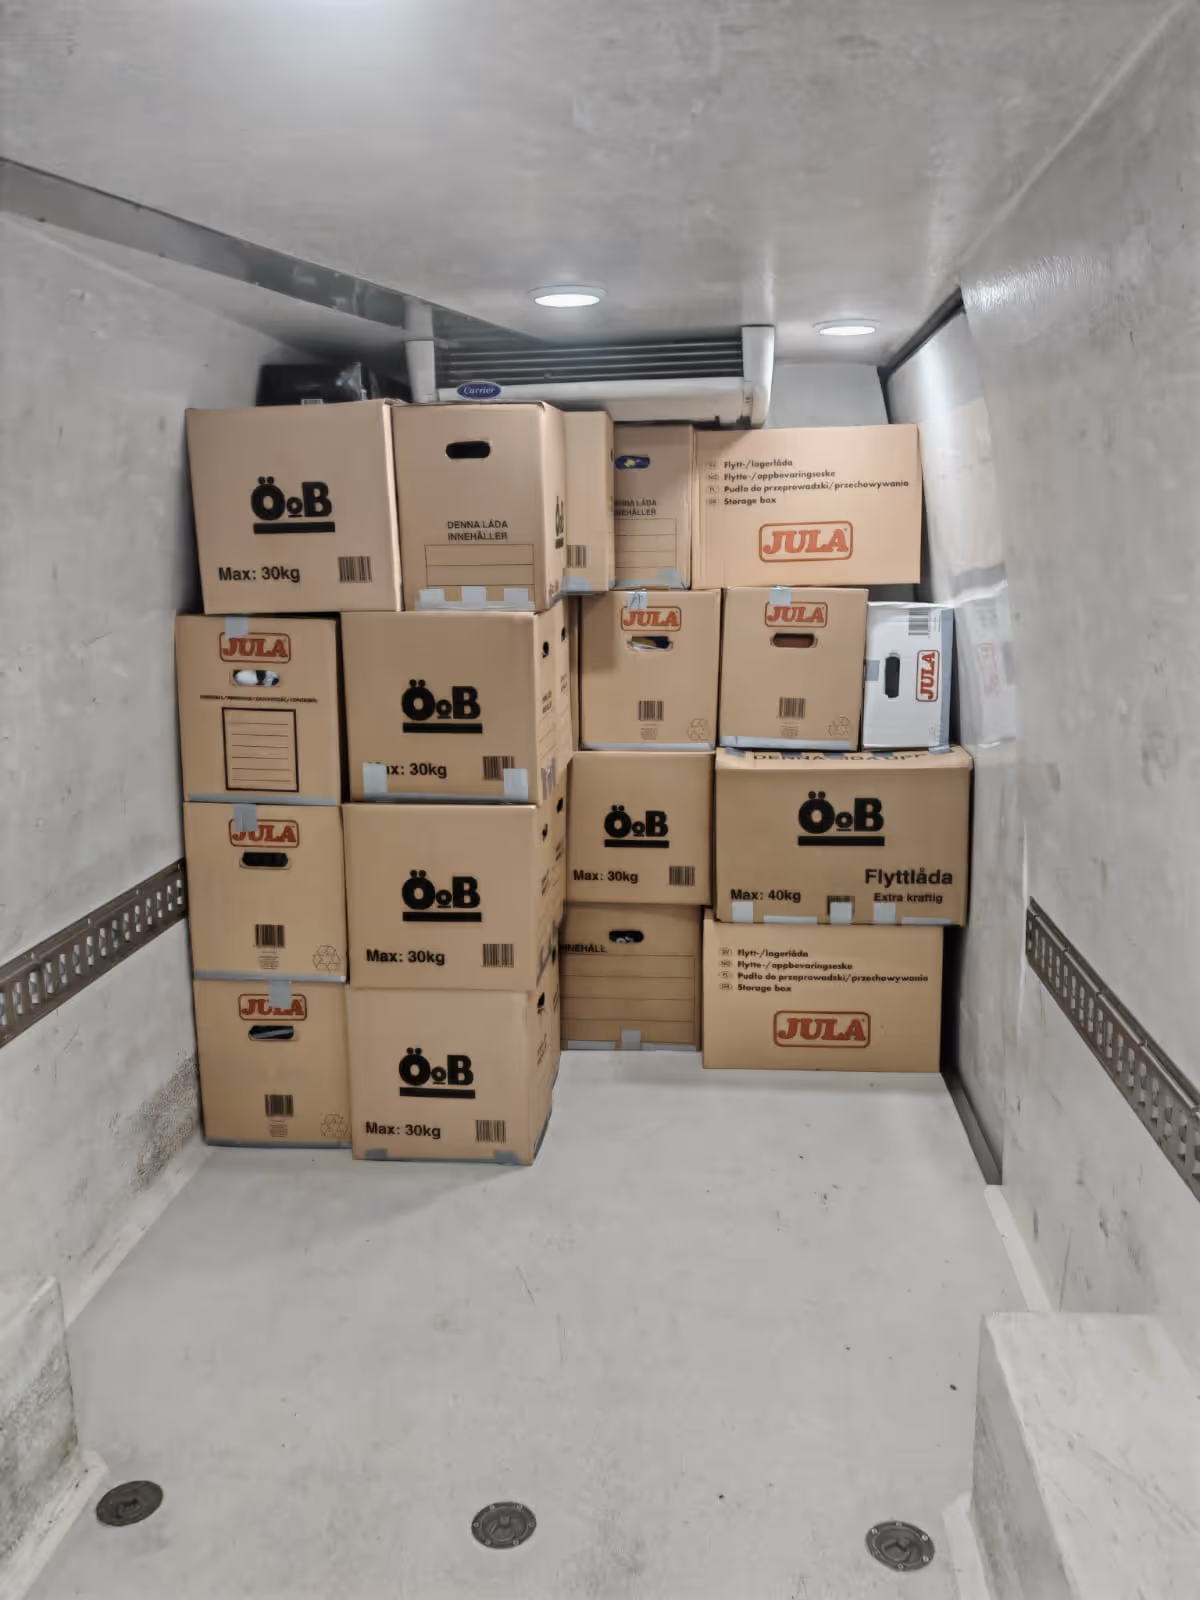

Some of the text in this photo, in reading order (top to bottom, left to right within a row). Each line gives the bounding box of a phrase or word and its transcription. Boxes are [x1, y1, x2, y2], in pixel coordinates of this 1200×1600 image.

[463, 385, 496, 395] Carrier
[750, 484, 762, 493] do
[251, 476, 333, 521] ÖoB
[723, 496, 757, 506] Storage
[759, 496, 776, 504] box
[447, 518, 509, 529] DENNA LÅDA
[447, 530, 508, 541] INNEHÅLLER
[762, 528, 849, 554] JULA
[218, 566, 300, 583] Max: 30kg
[623, 610, 680, 627] JULA
[767, 606, 825, 623] JULA
[222, 637, 289, 658] JULA
[920, 652, 936, 700] JULA
[401, 679, 481, 721] ÖoB
[409, 762, 448, 779] 30kg
[798, 791, 885, 834] ÖoB
[604, 805, 669, 838] ÖoB
[573, 869, 639, 885] Max: 30kg
[864, 867, 954, 888] Flyttlåda
[401, 870, 481, 910] ÖoB
[730, 889, 802, 903] Max: 40kg
[873, 892, 944, 904] Extra kraftig
[366, 948, 446, 966] Max: 30kg
[765, 972, 777, 981] do
[737, 983, 772, 993] Storage
[774, 984, 792, 993] box
[777, 1017, 867, 1041] JULA
[399, 1047, 474, 1086] ÖoB
[365, 1121, 442, 1140] Max: 30kg
